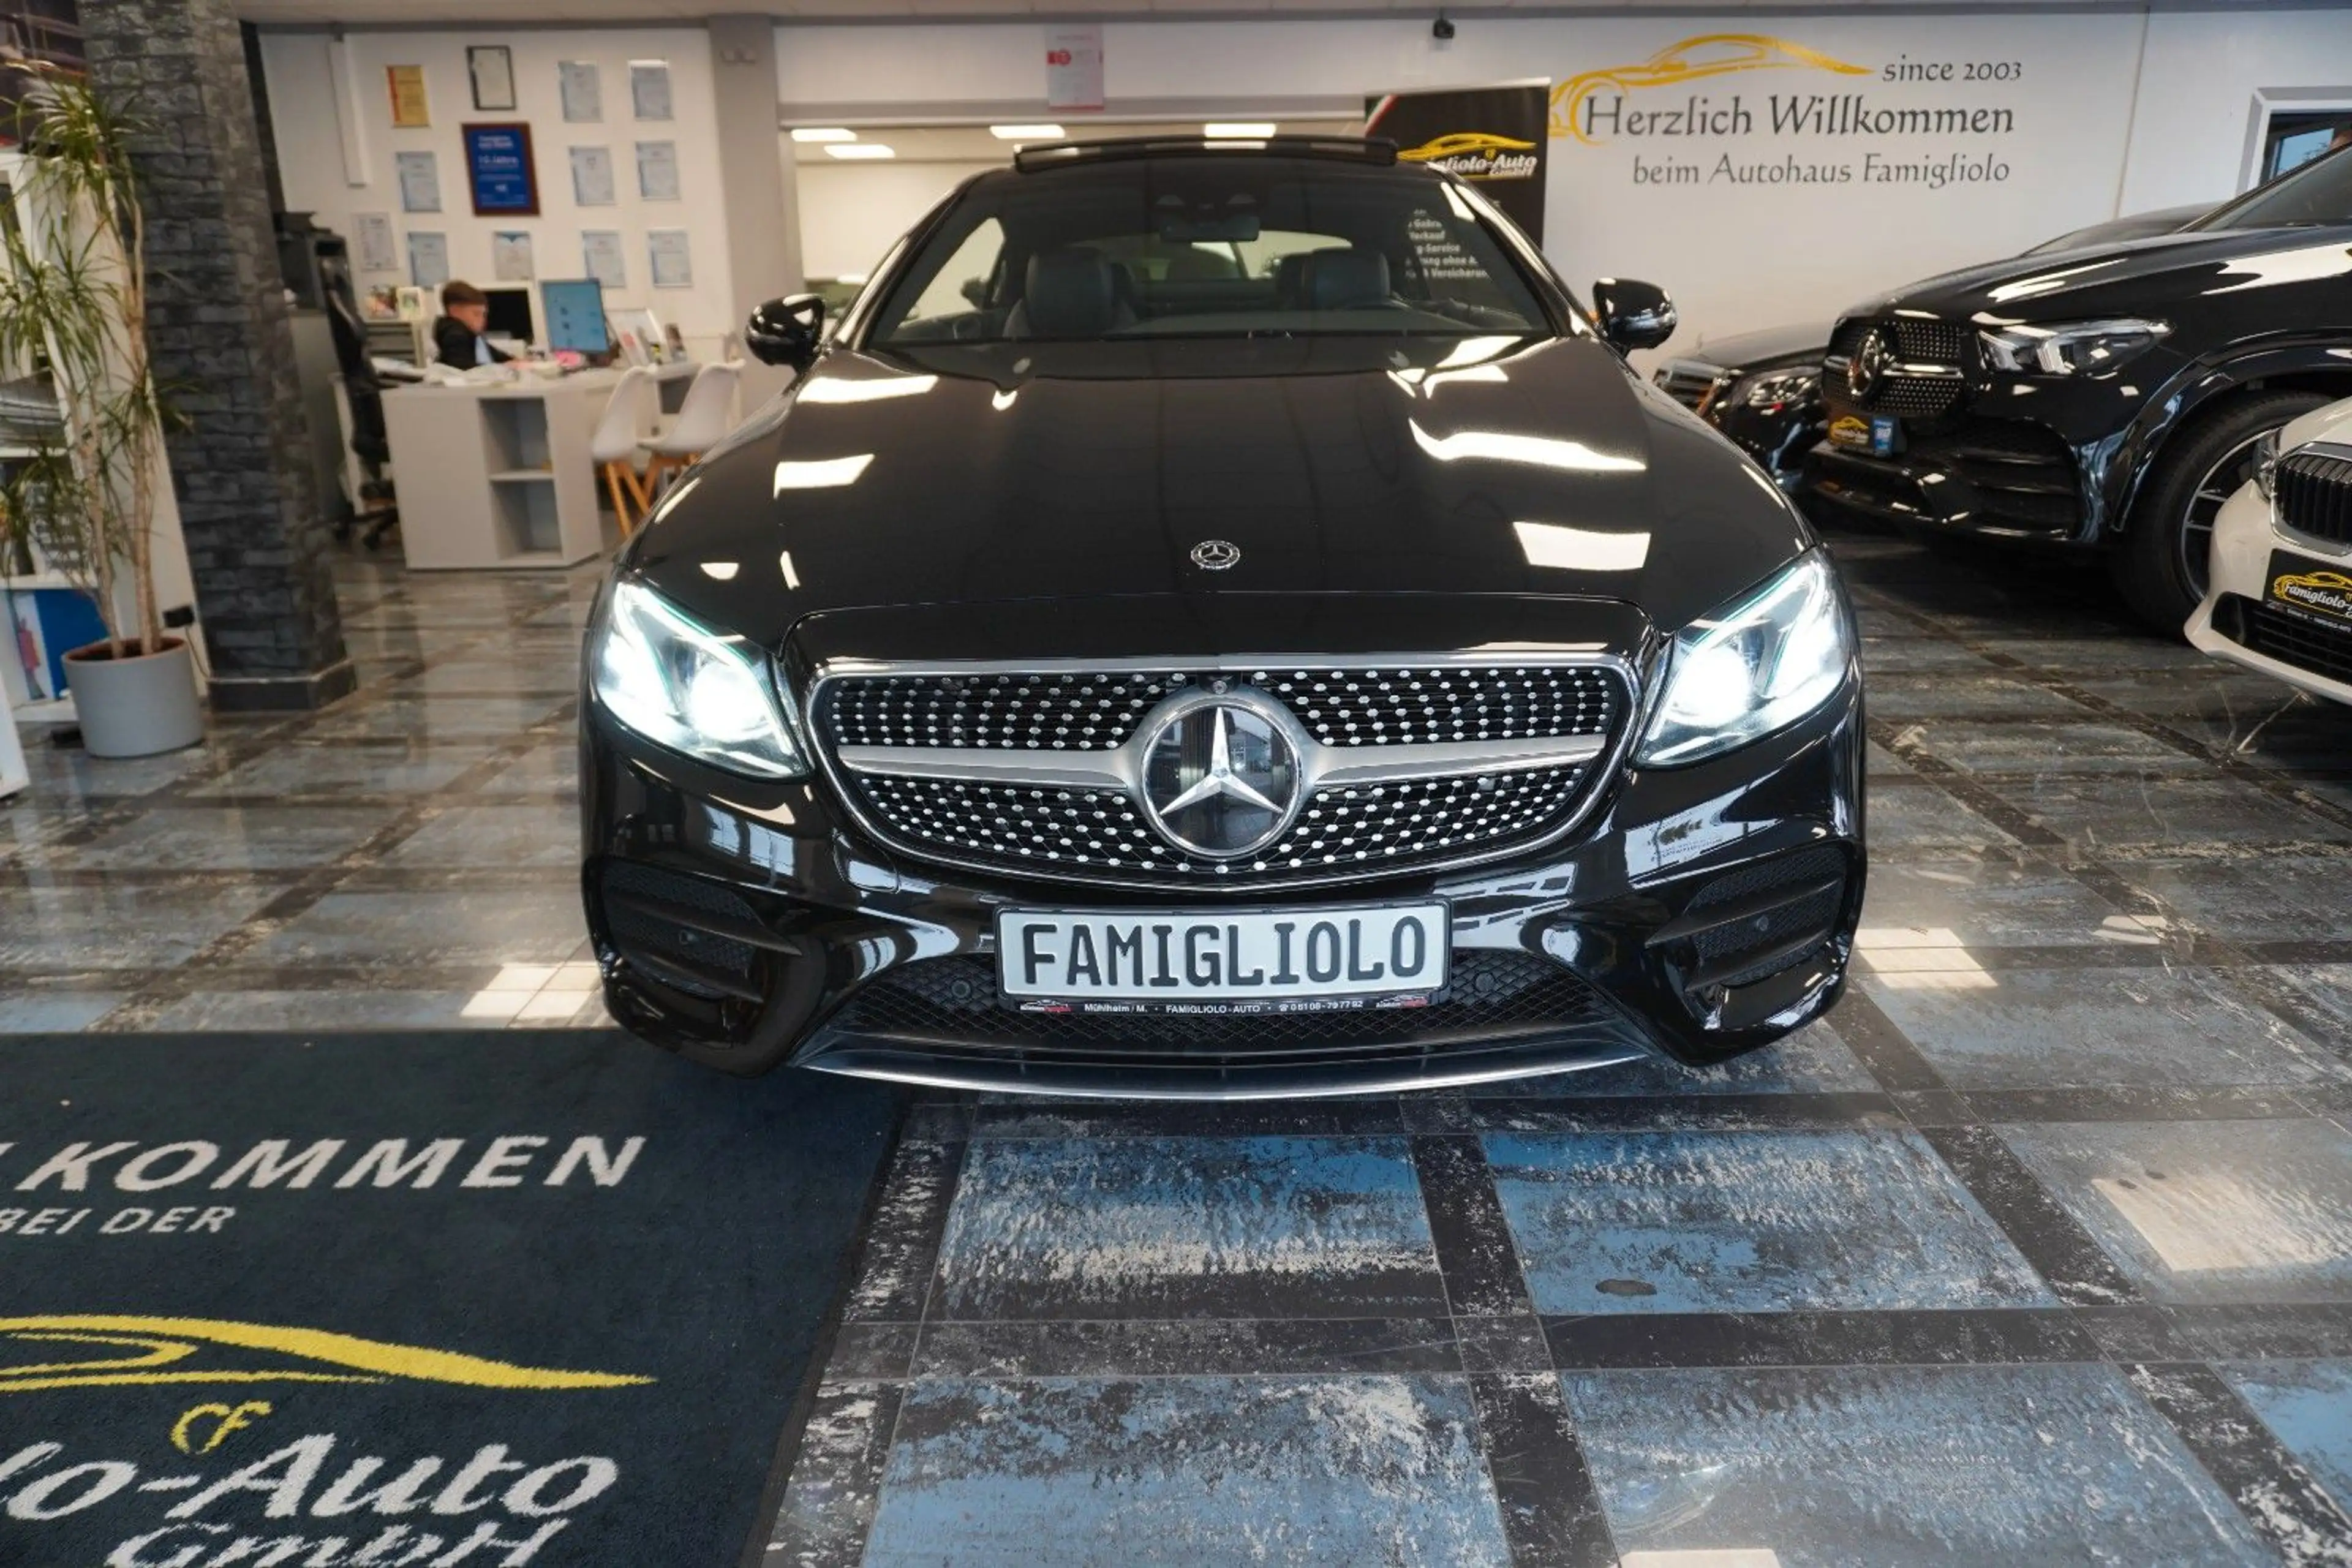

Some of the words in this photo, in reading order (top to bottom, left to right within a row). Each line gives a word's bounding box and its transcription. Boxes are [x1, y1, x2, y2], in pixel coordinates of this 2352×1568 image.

[1883, 55, 1954, 81] since
[1962, 62, 2021, 81] 2003
[1586, 94, 1752, 136] Herzlich
[1769, 94, 2014, 135] Willkommen
[1634, 155, 1700, 184] beim
[1708, 153, 1851, 184] Autohaus
[1863, 153, 2010, 189] Famigliolo
[1022, 915, 1426, 987] FAMIGLIOLO
[0, 1136, 647, 1191] KOMMEN
[98, 1206, 237, 1235] DER
